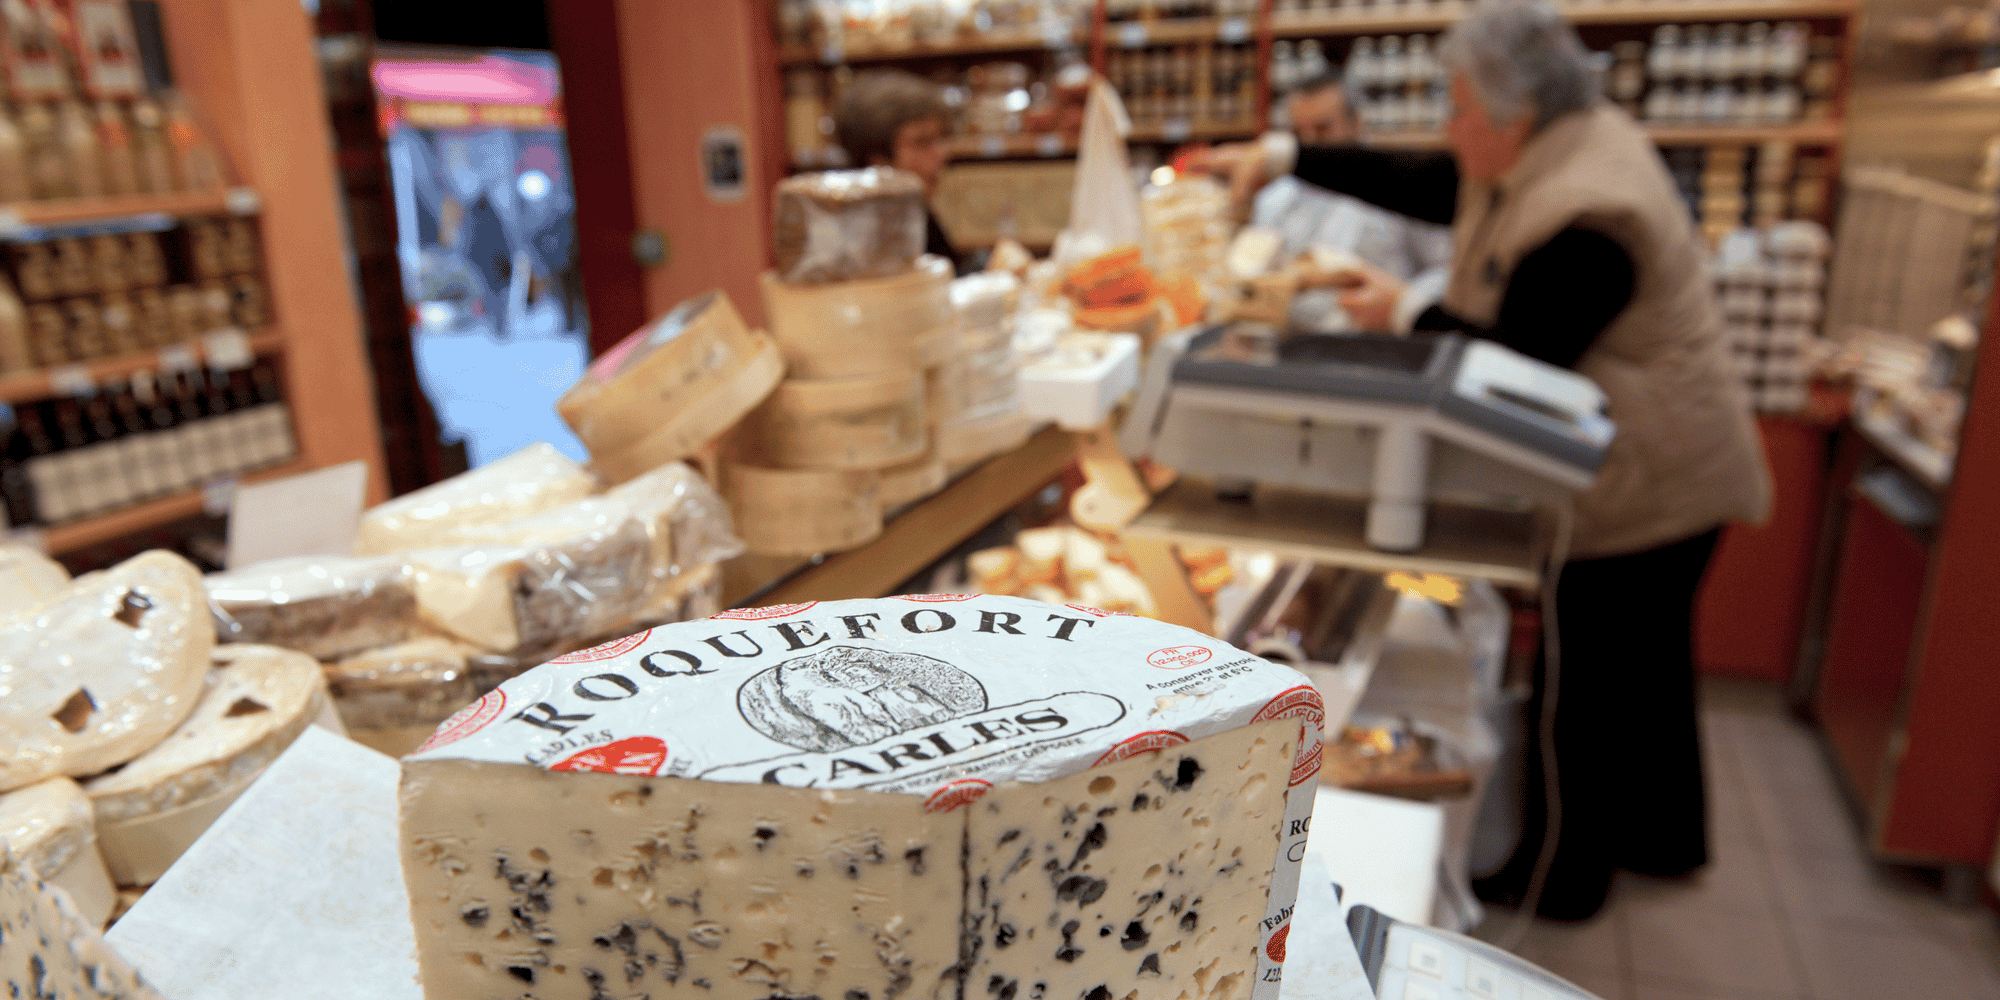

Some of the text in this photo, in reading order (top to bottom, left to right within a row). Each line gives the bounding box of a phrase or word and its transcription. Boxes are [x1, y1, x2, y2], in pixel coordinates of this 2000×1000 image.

[502, 608, 1095, 736] ROQUEFORT
[1145, 683, 1158, 691] A
[1157, 667, 1214, 689] conserver
[1215, 662, 1230, 672] au
[1173, 680, 1204, 694] entre
[1219, 672, 1233, 680] et
[762, 707, 1068, 787] CARLES
